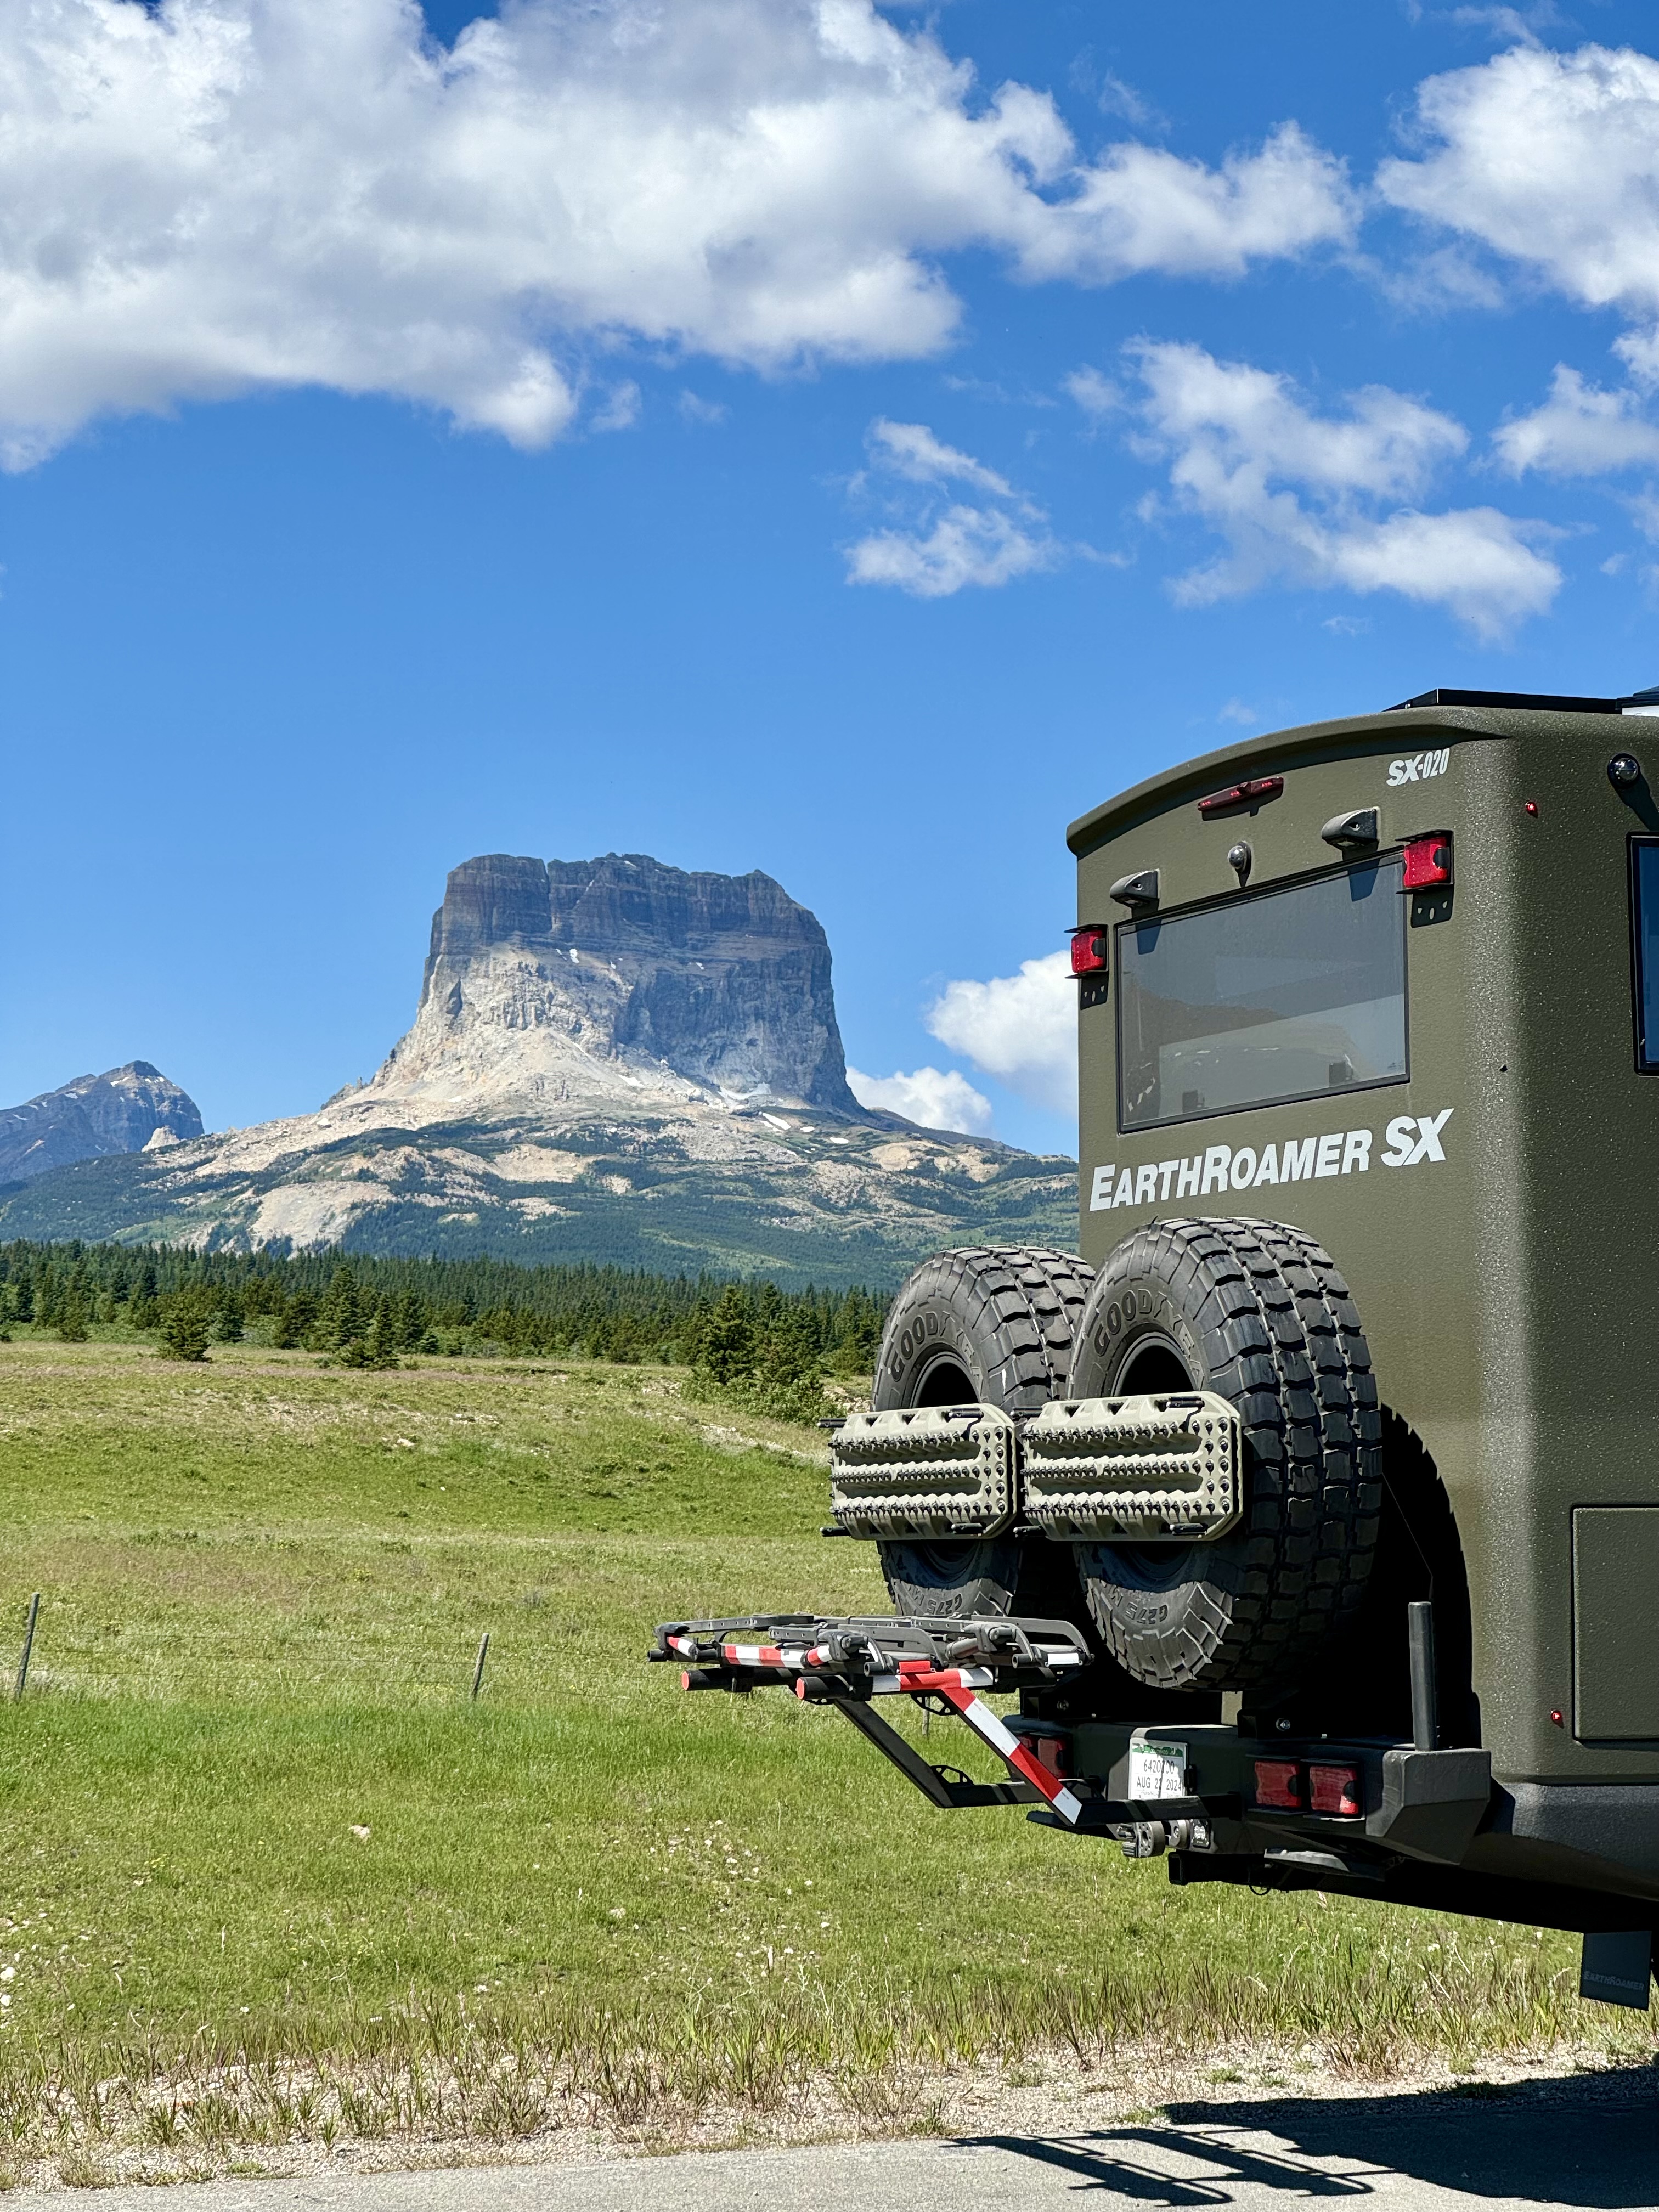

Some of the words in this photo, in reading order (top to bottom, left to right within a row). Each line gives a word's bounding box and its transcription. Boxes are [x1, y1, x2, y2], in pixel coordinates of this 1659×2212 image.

[1386, 748, 1450, 787] SX-020
[1090, 1129, 1372, 1211] EARTHROAMER
[1380, 1108, 1454, 1167] SX
[1125, 1605, 1168, 1624] G275
[1136, 1776, 1151, 1789] AUG
[1166, 1779, 1182, 1791] 2024
